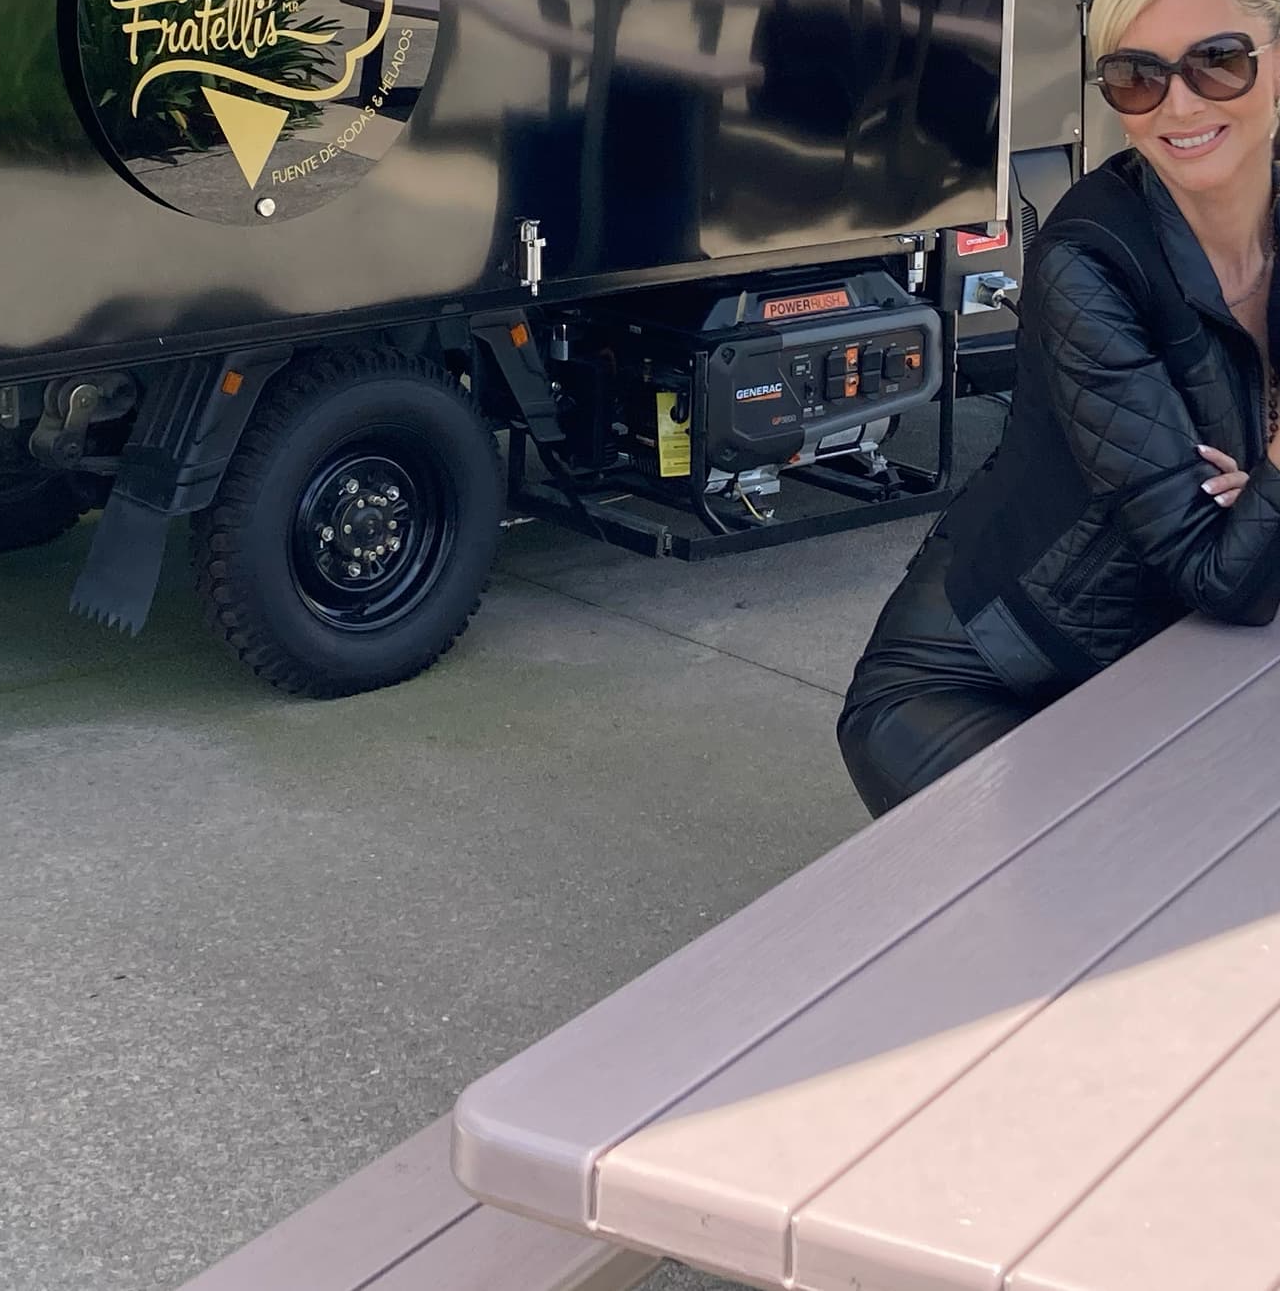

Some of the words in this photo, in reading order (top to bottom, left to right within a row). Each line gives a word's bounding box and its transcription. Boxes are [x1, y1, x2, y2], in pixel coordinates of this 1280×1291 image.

[272, 154, 320, 186] FUENTE
[320, 143, 339, 164] DE
[337, 105, 376, 149] SODAS
[372, 94, 384, 108] &
[378, 28, 414, 96] HELADOS
[736, 382, 783, 400] GENERAC
